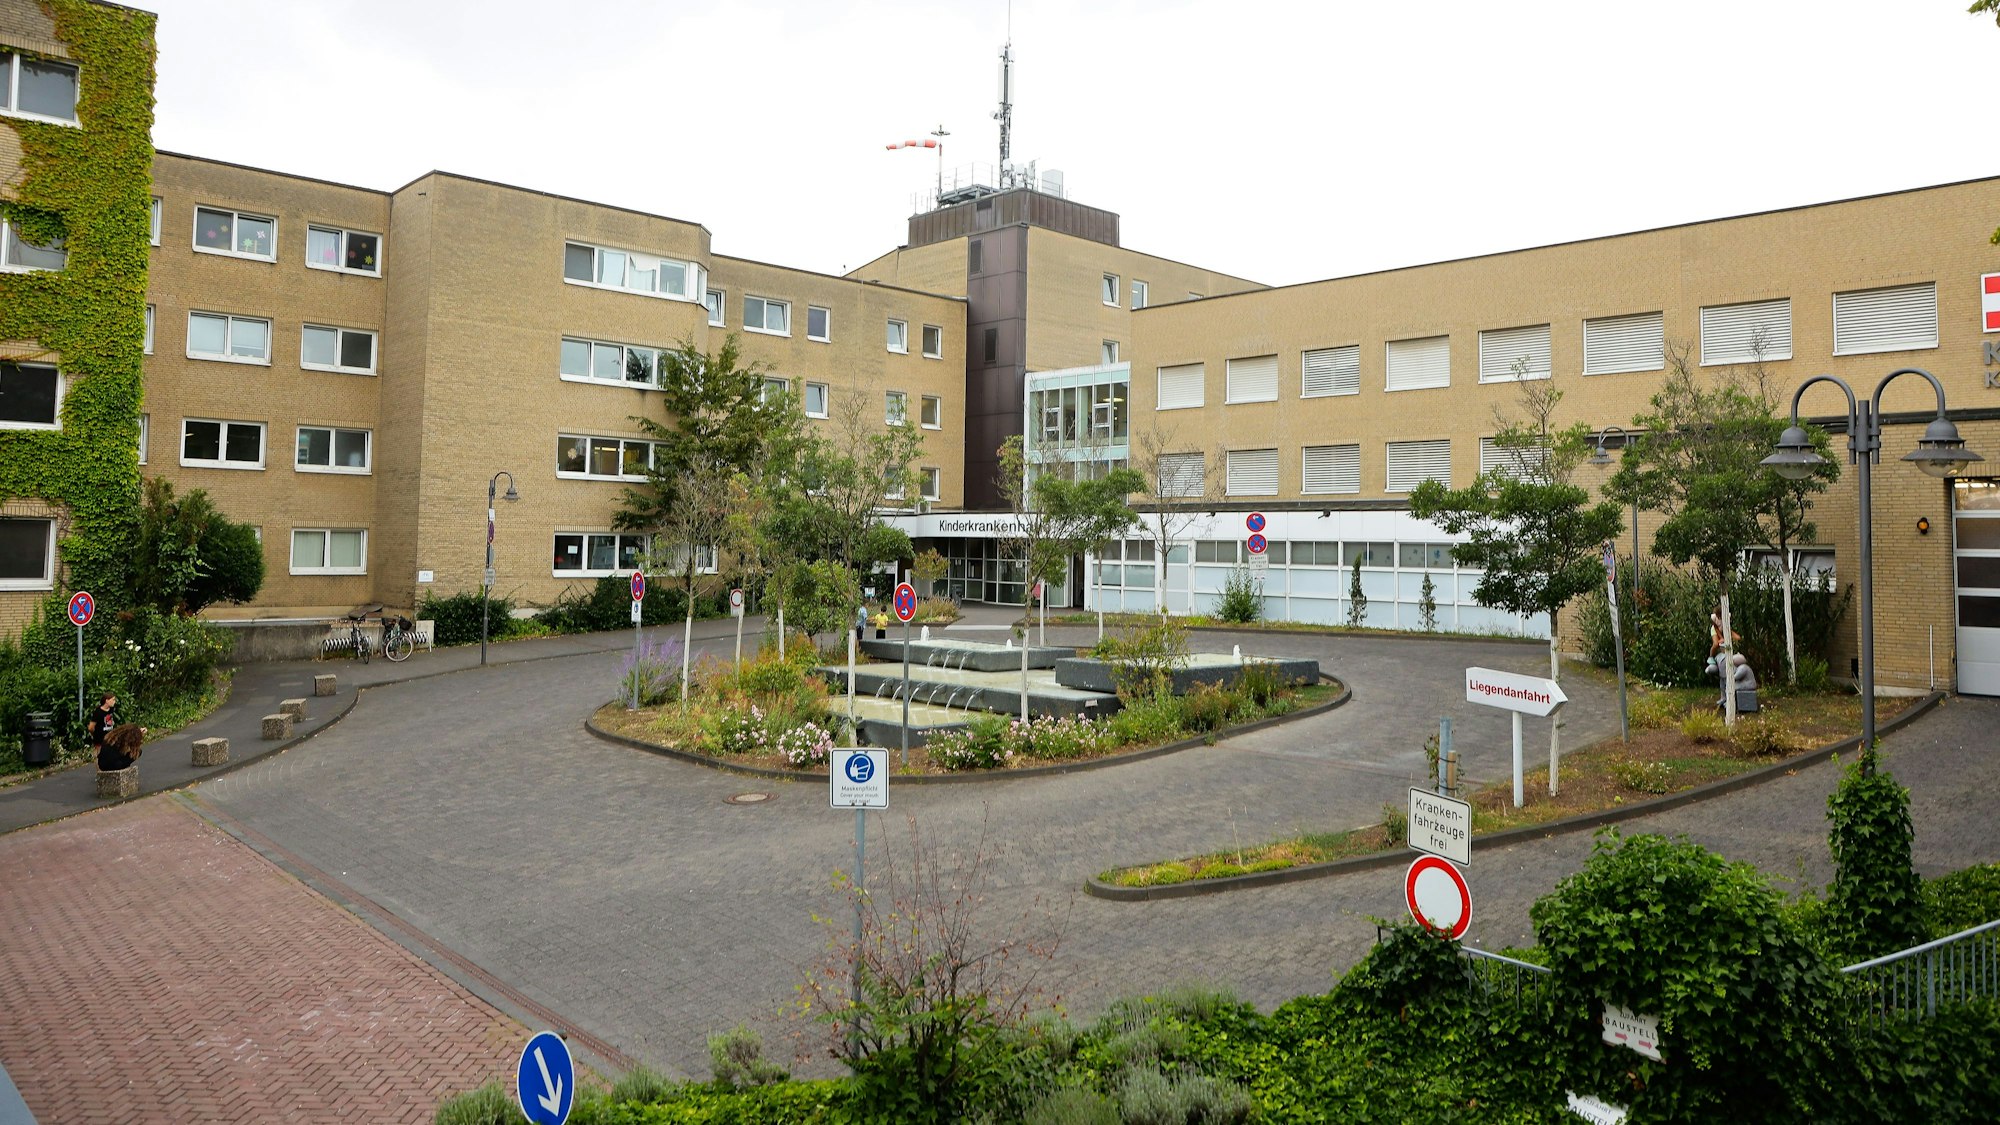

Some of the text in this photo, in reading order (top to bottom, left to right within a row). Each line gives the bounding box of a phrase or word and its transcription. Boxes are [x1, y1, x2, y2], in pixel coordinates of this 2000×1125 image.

[939, 519, 1033, 533] Kinderkrankenha
[1469, 679, 1551, 704] Liegendanfahrt
[1415, 797, 1463, 821] Kranken-
[1414, 813, 1465, 840] fahrzeuge
[1430, 834, 1447, 850] frei
[1605, 1016, 1656, 1041] BAUSTELL
